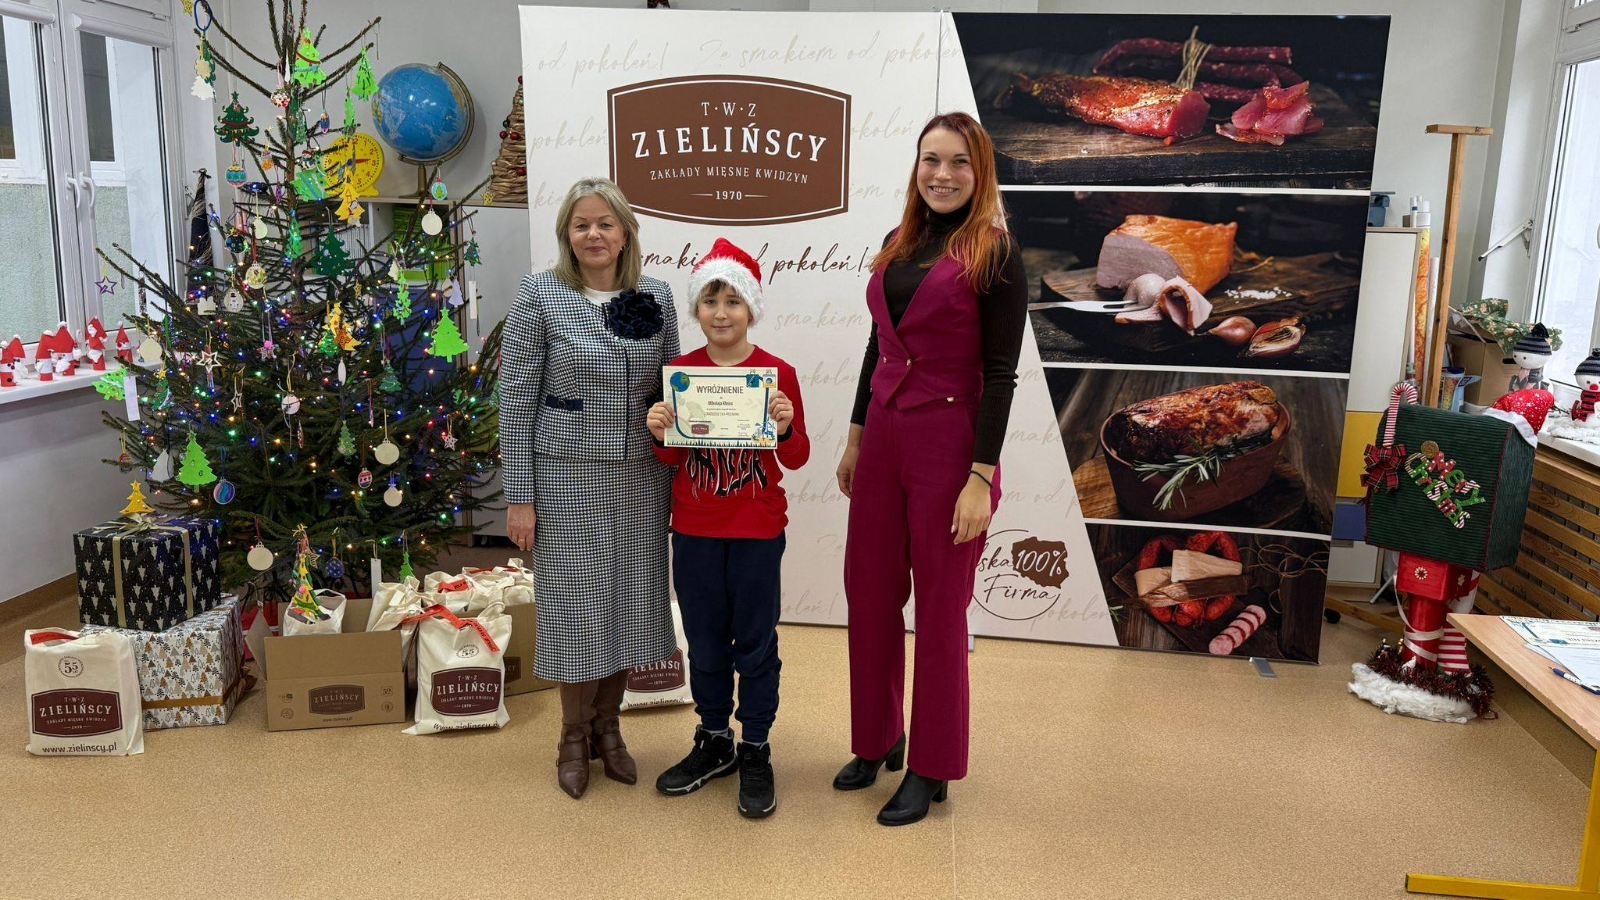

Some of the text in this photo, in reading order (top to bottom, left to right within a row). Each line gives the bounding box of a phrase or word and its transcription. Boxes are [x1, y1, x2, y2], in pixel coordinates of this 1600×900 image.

[738, 34, 836, 68] smakiem
[847, 30, 880, 61] od
[631, 122, 827, 162] ZIELIŃSCY
[650, 166, 809, 184] ZAKŁADY MIĘSNE KWIDZYN
[715, 190, 742, 200] 1970
[640, 242, 699, 269] maki
[769, 242, 869, 286] pokoleń!
[774, 301, 865, 330] smakiem
[1015, 549, 1067, 577] 100%
[983, 573, 1057, 604] Firma
[437, 681, 500, 696] ZIELIŃSCY
[40, 703, 112, 717] ZIELIŃSCY
[42, 742, 117, 753] www.zielinscy.pl
